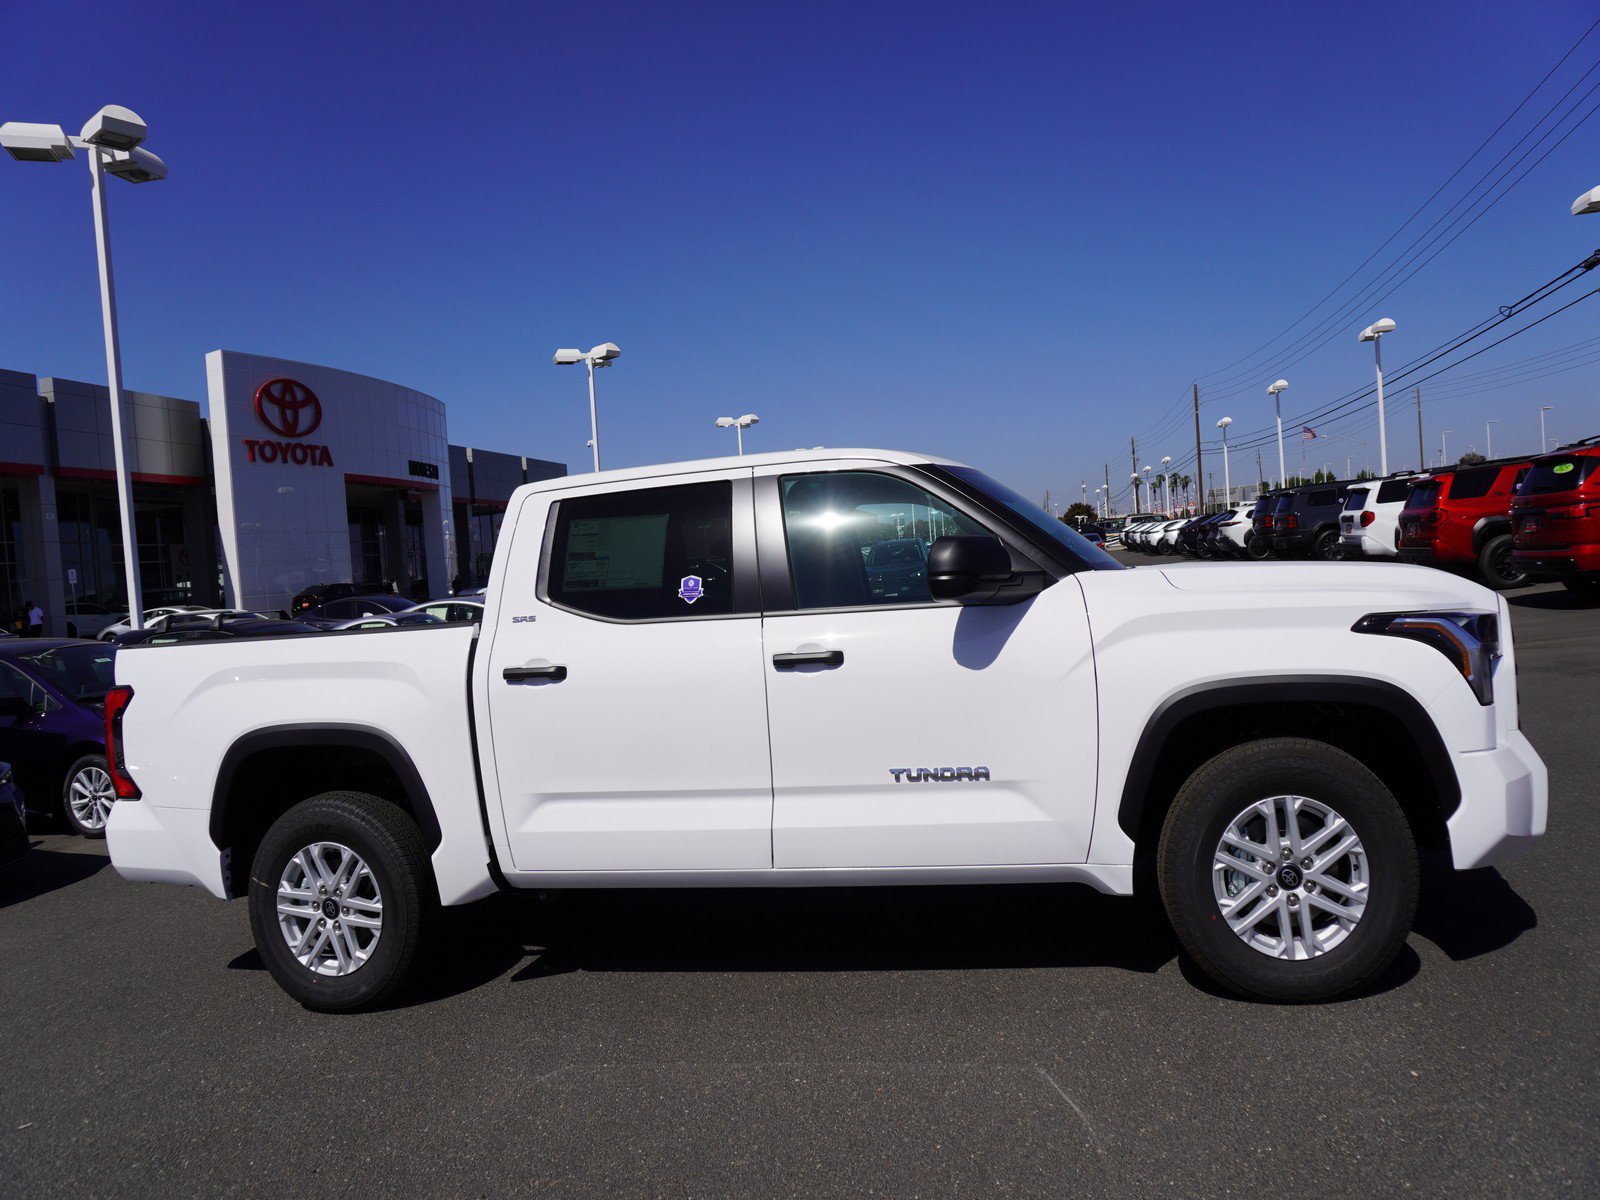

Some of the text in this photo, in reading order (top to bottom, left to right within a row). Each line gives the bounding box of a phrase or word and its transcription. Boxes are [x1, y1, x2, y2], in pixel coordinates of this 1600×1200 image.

[243, 439, 334, 467] TOYOTA
[512, 615, 537, 624] SR5
[888, 765, 991, 783] TUNDRA
